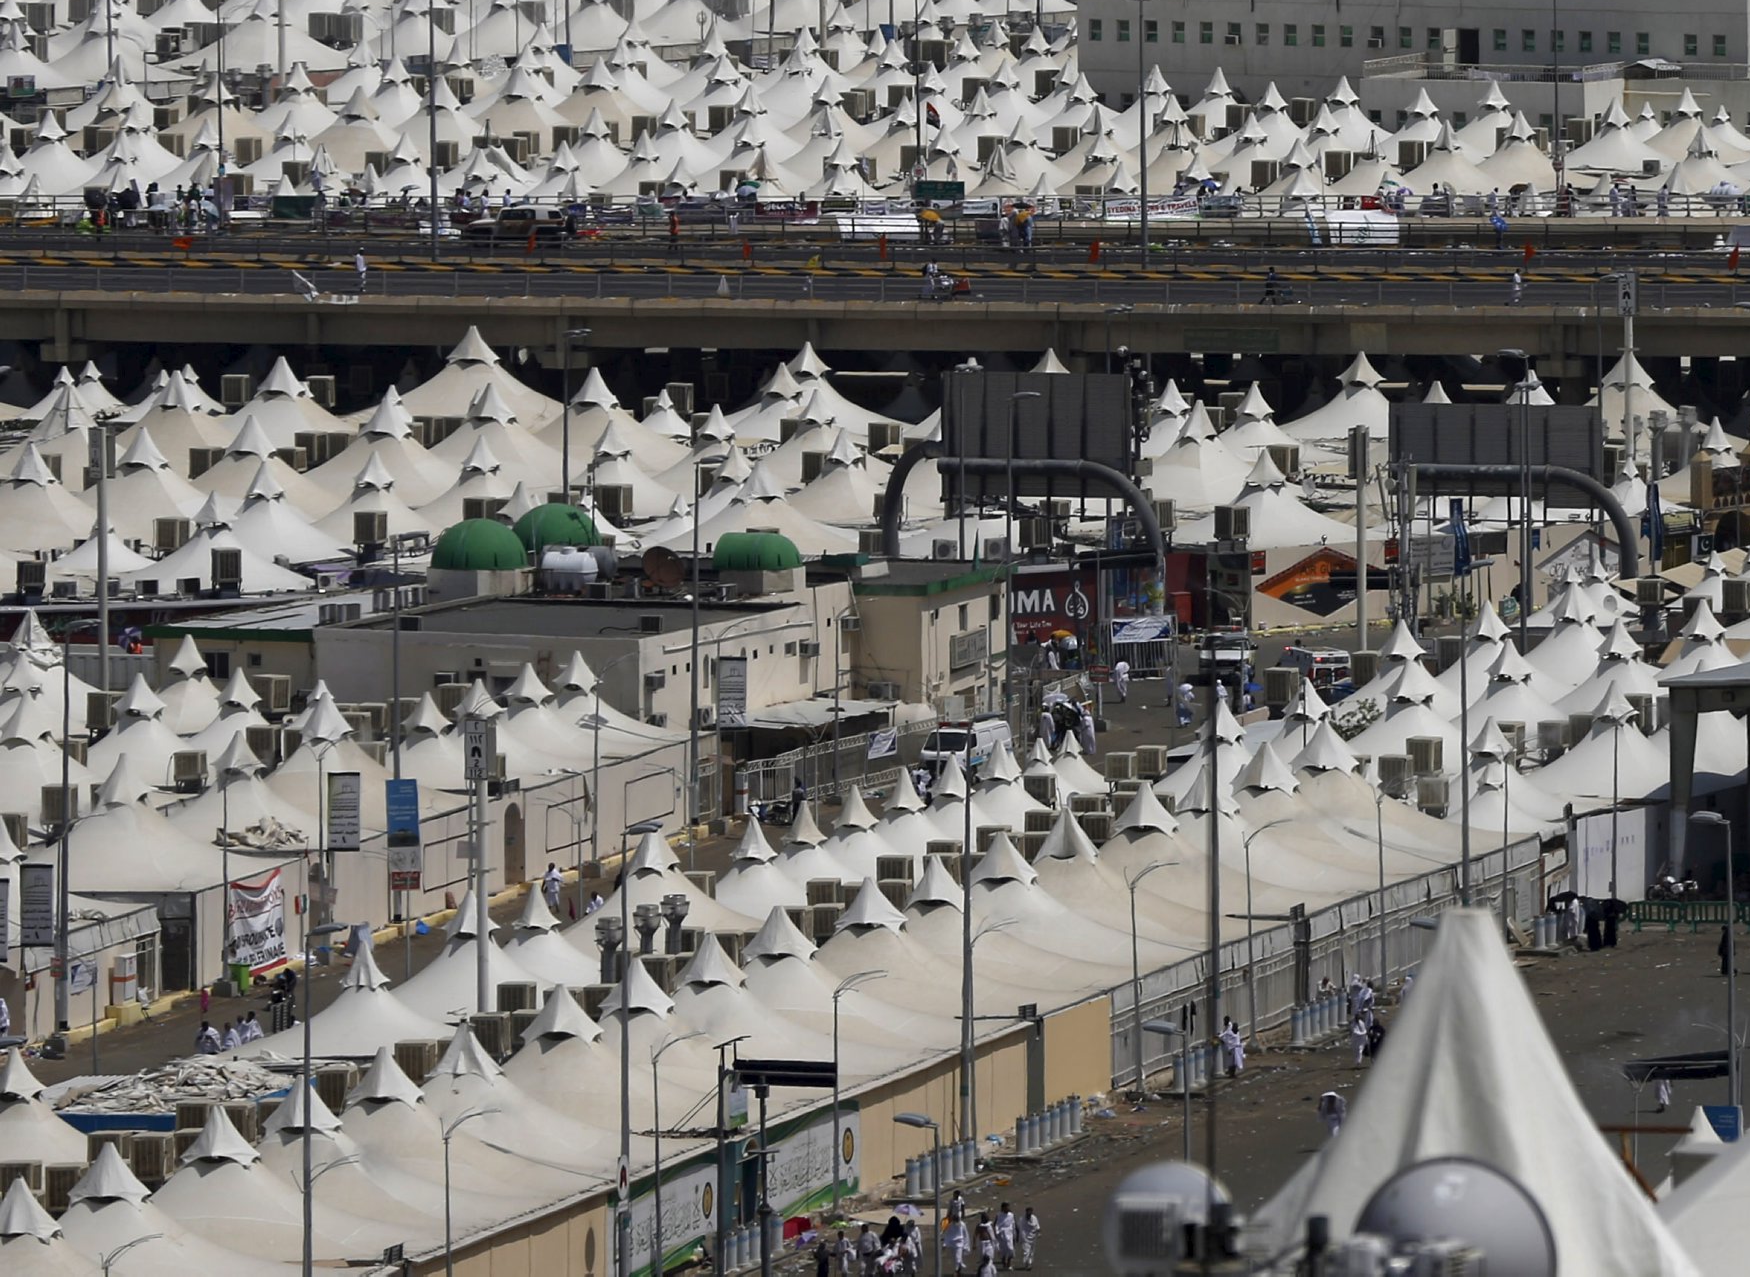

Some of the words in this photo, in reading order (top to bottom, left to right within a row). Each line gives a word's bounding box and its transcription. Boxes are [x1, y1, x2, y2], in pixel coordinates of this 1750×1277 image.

[1167, 200, 1197, 211] TRAVELS
[474, 759, 479, 767] 2
[470, 769, 482, 778] 112
